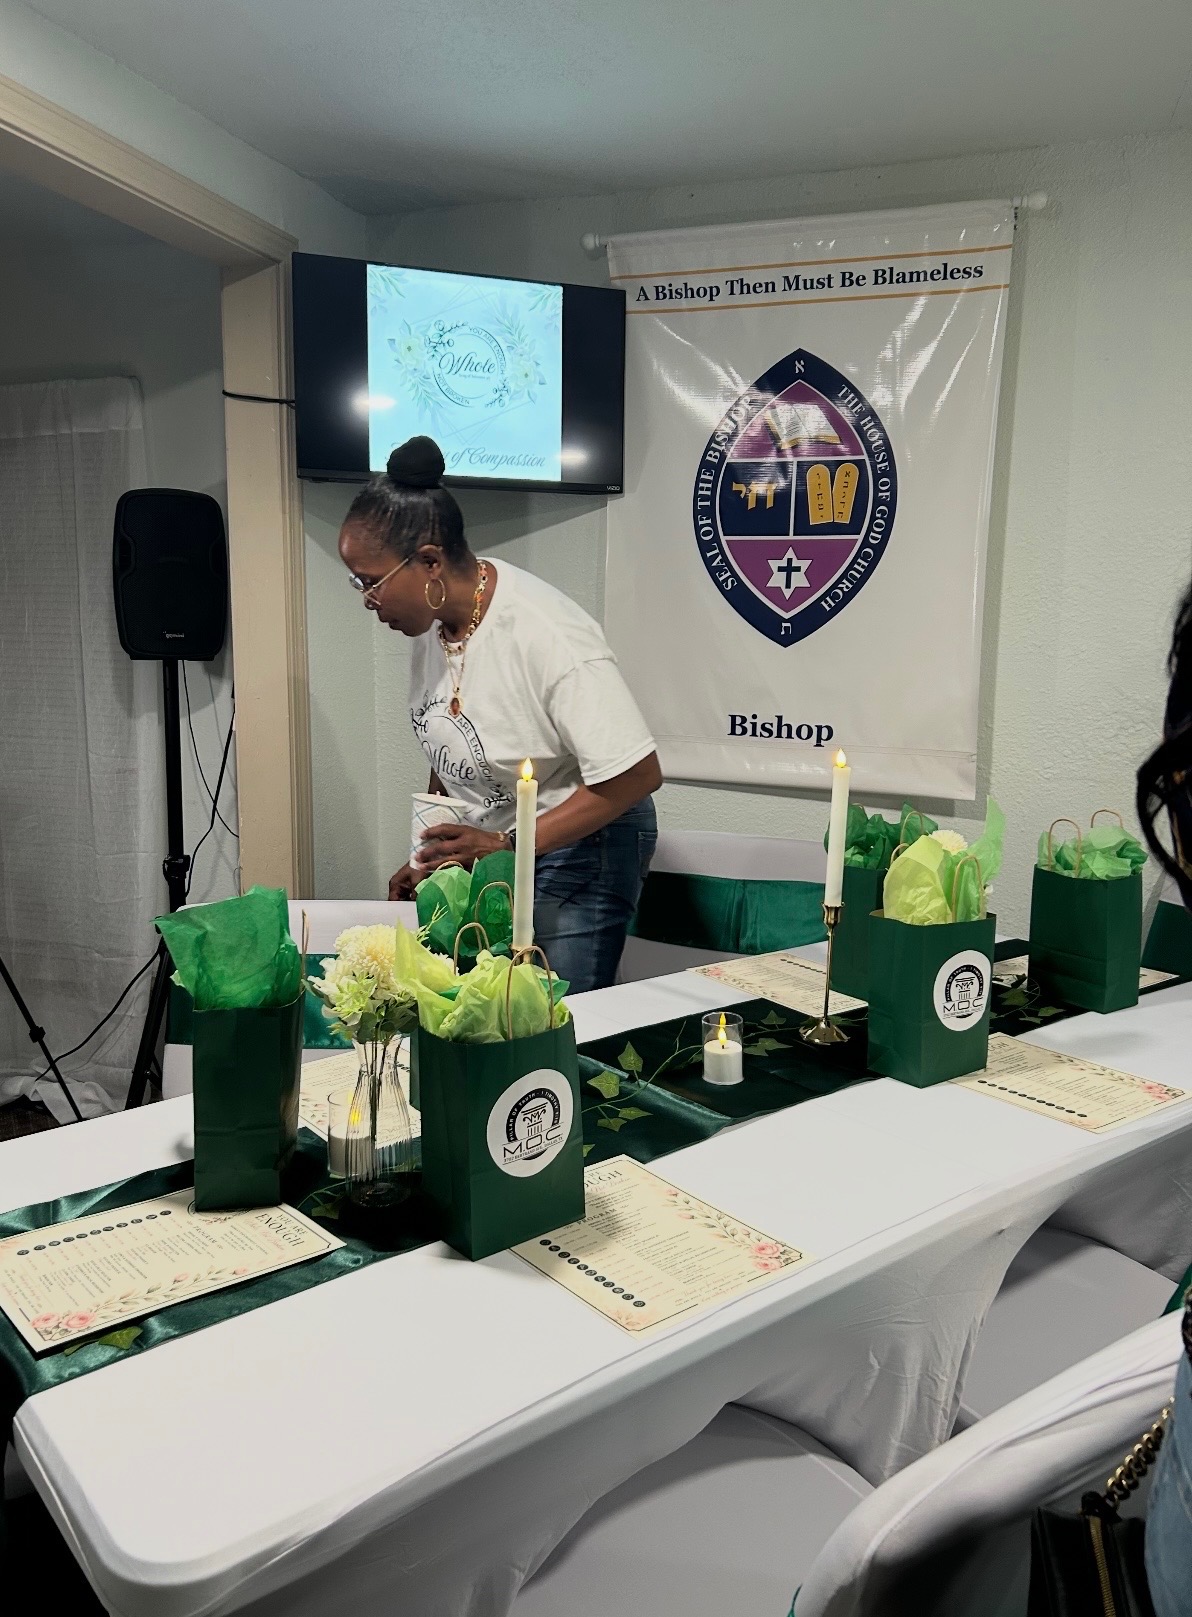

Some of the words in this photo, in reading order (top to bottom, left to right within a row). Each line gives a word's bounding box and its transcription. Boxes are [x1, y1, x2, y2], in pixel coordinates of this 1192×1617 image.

[635, 285, 651, 301] A
[654, 282, 721, 302] Bishop
[725, 276, 777, 297] Then
[782, 272, 834, 292] Must
[840, 270, 867, 288] Be
[872, 262, 985, 286] Blameless
[469, 326, 483, 335] YOU
[439, 352, 495, 375] Whole
[836, 384, 865, 417] THE
[706, 395, 753, 464] BISHOP
[859, 415, 891, 474] HOUSE
[468, 447, 546, 471] Compassion
[697, 468, 715, 510] THE
[878, 482, 891, 502] OF
[697, 514, 714, 541] OF
[868, 505, 889, 545] GOD
[706, 543, 738, 591] SEAL
[820, 548, 874, 612] CHURCH
[727, 713, 834, 747] Bishop
[421, 740, 477, 781] Whole
[469, 737, 495, 781] ENOUGH
[255, 1213, 305, 1247] ENOUGH
